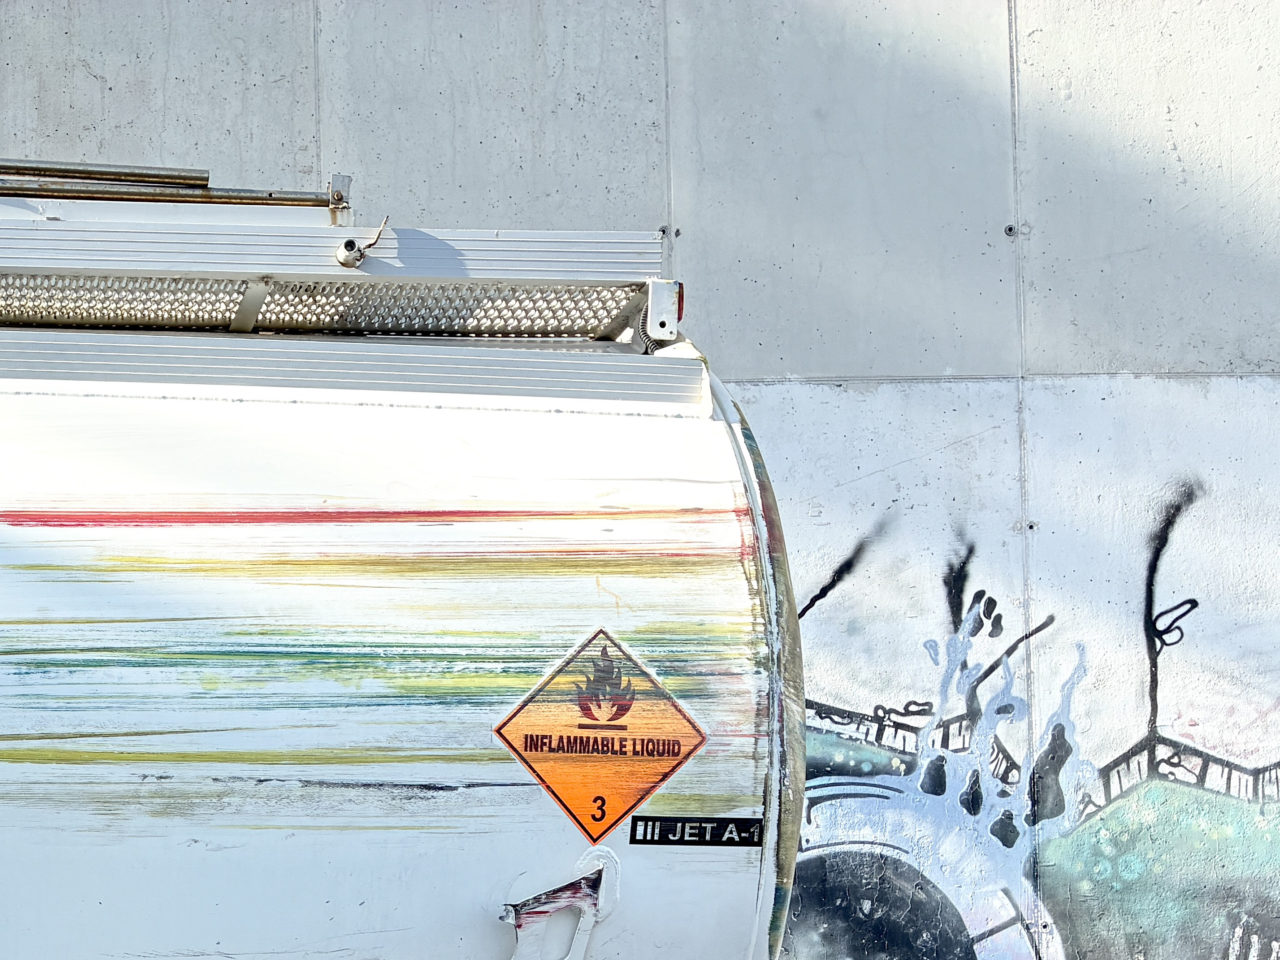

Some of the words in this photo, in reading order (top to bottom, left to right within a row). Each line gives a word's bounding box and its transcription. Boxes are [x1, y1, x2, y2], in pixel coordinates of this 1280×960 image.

[524, 734, 628, 756] INFLAMMABLE
[631, 738, 682, 758] LIQUID
[590, 796, 607, 823] 3
[668, 822, 717, 842] JET
[721, 823, 761, 843] A-1
